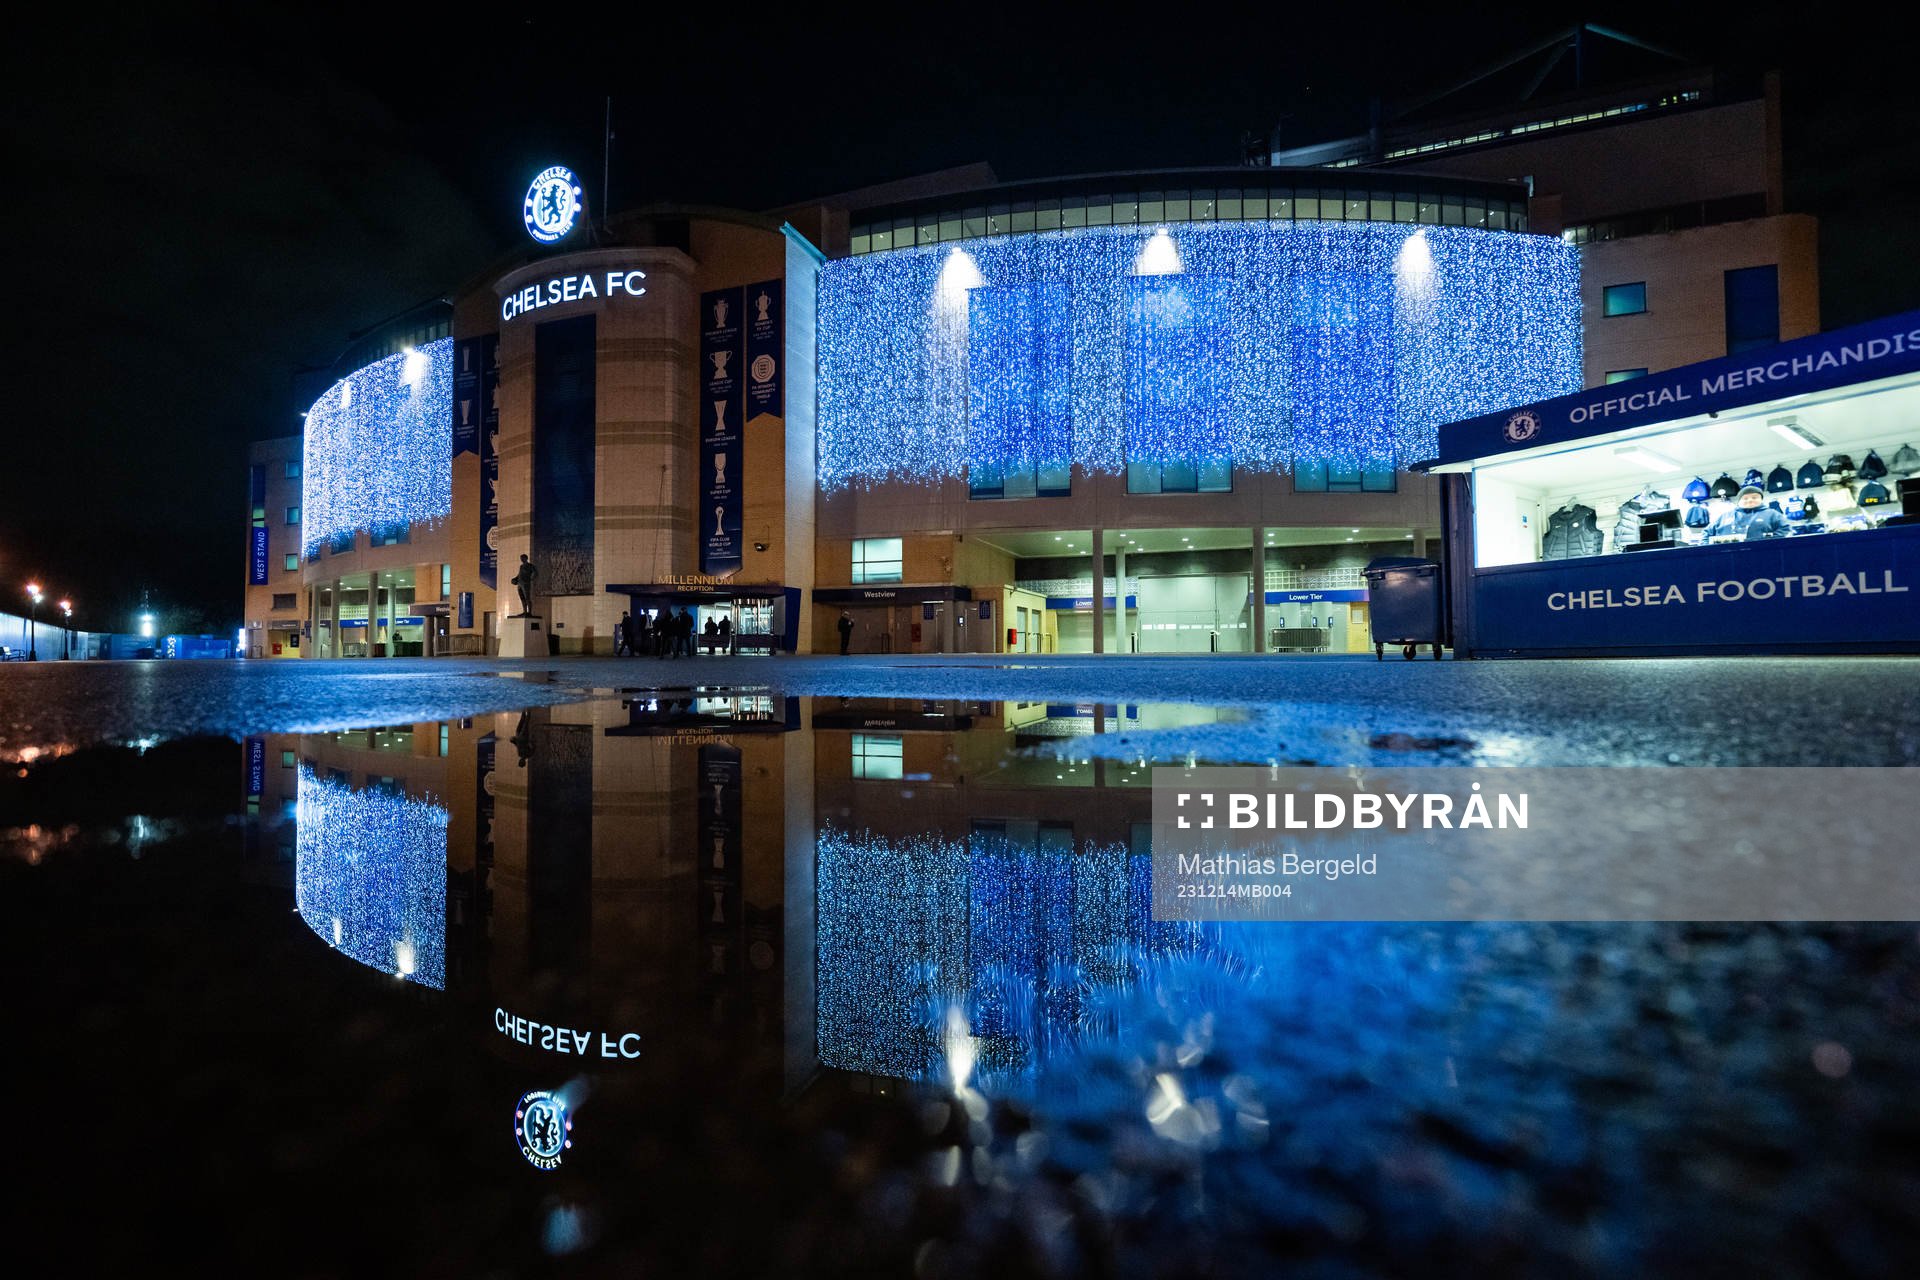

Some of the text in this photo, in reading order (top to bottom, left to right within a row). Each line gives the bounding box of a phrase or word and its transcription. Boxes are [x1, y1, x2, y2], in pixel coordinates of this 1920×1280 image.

[534, 168, 572, 190] CHELSEA
[502, 270, 646, 321] CHELSEA FC
[1569, 385, 1691, 424] OFFICIAL
[257, 559, 265, 580] WEST
[658, 575, 734, 585] MILLENNIUM
[1548, 570, 1908, 610] CHELSEA FOOTBALL
